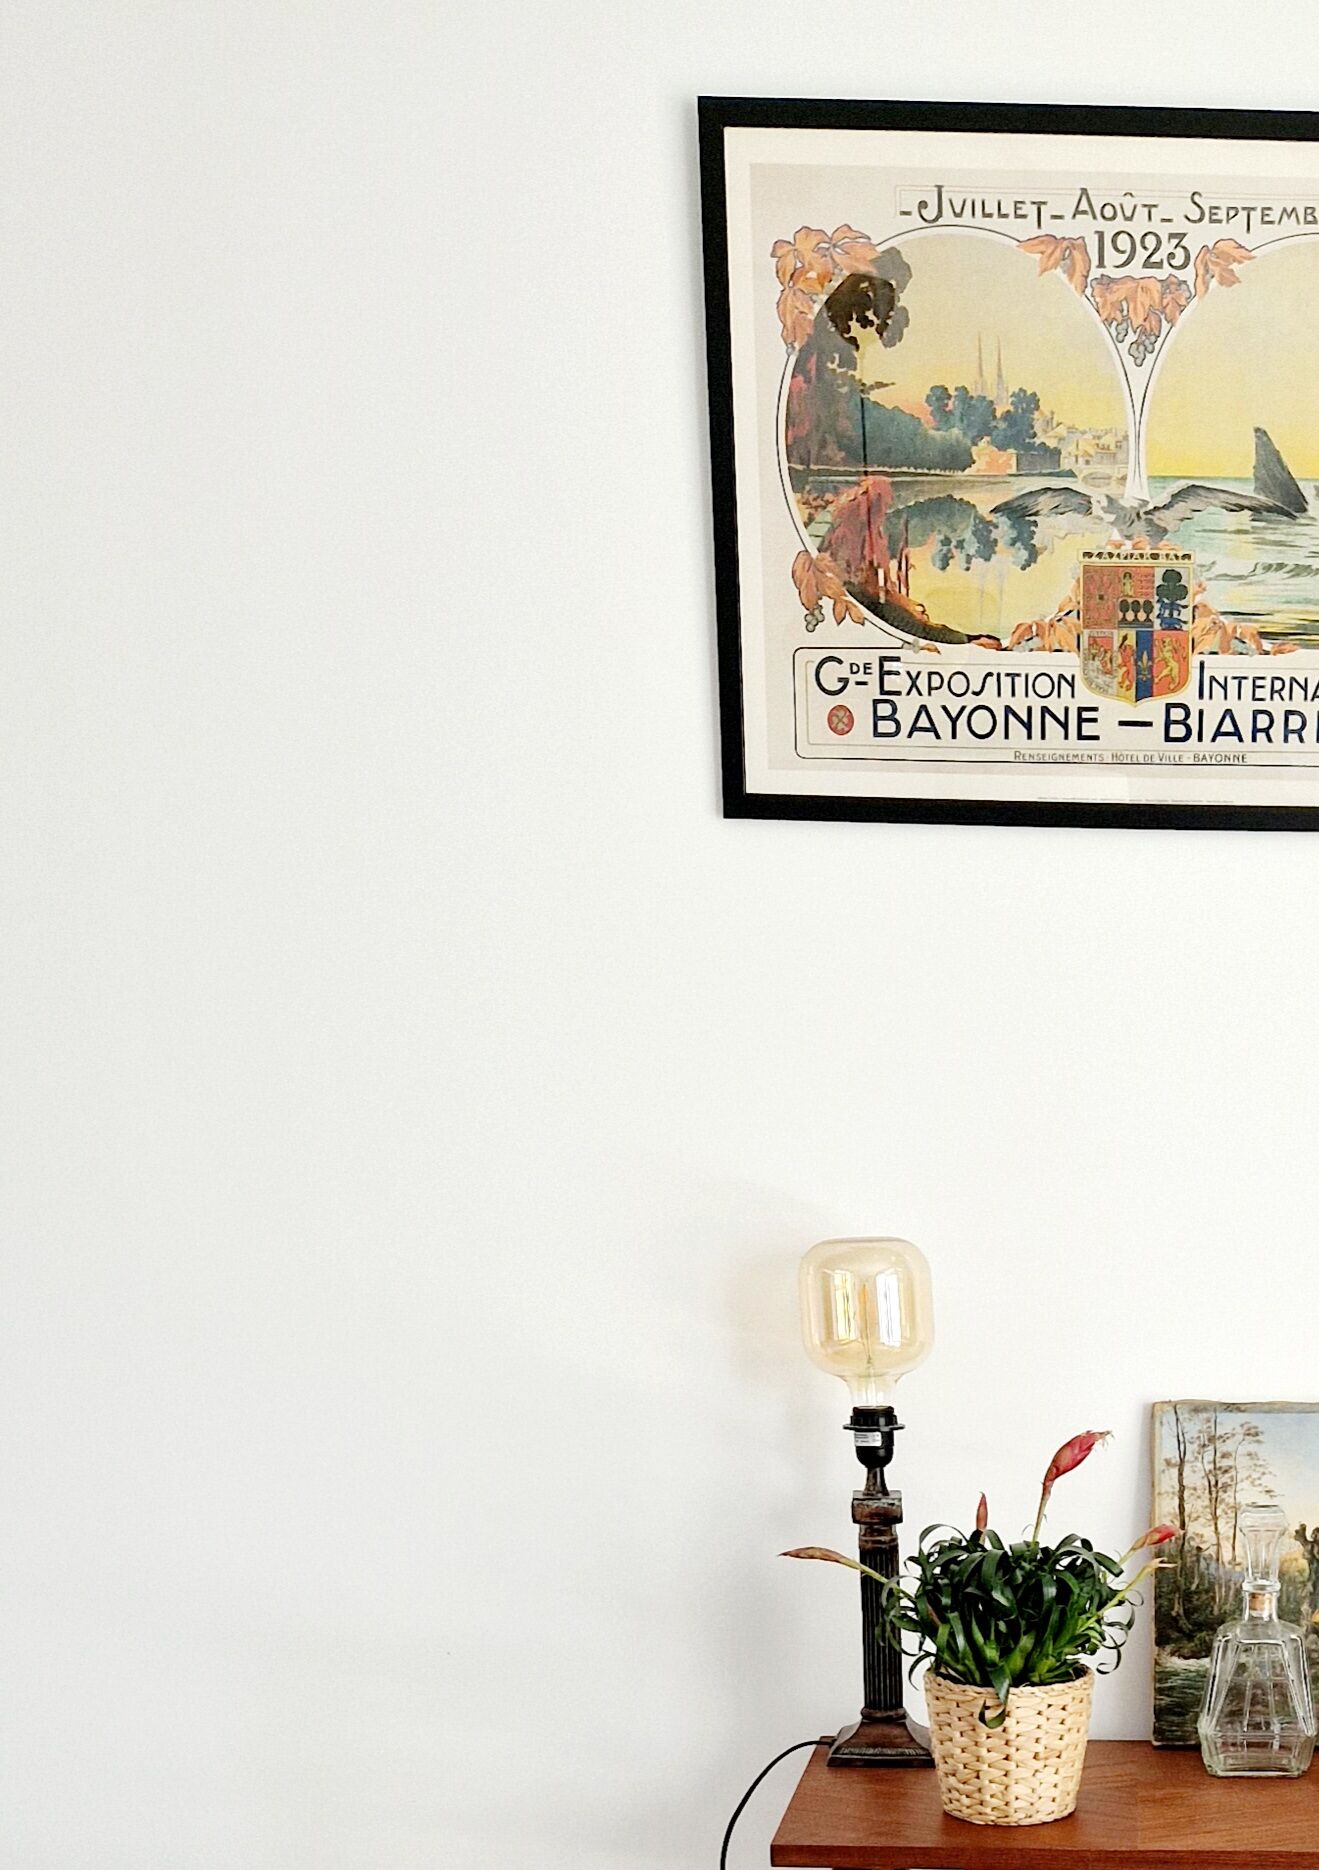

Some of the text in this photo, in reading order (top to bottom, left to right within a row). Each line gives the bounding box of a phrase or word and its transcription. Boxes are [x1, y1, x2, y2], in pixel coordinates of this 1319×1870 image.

[1094, 230, 1191, 270] 1923
[879, 656, 1075, 698] EXPOSITION
[872, 699, 1100, 741] BAYONNE
[1014, 751, 1104, 762] RENSEIGNEMENTS
[1158, 752, 1183, 763] VILLE
[1193, 752, 1248, 763] BAYONNE
